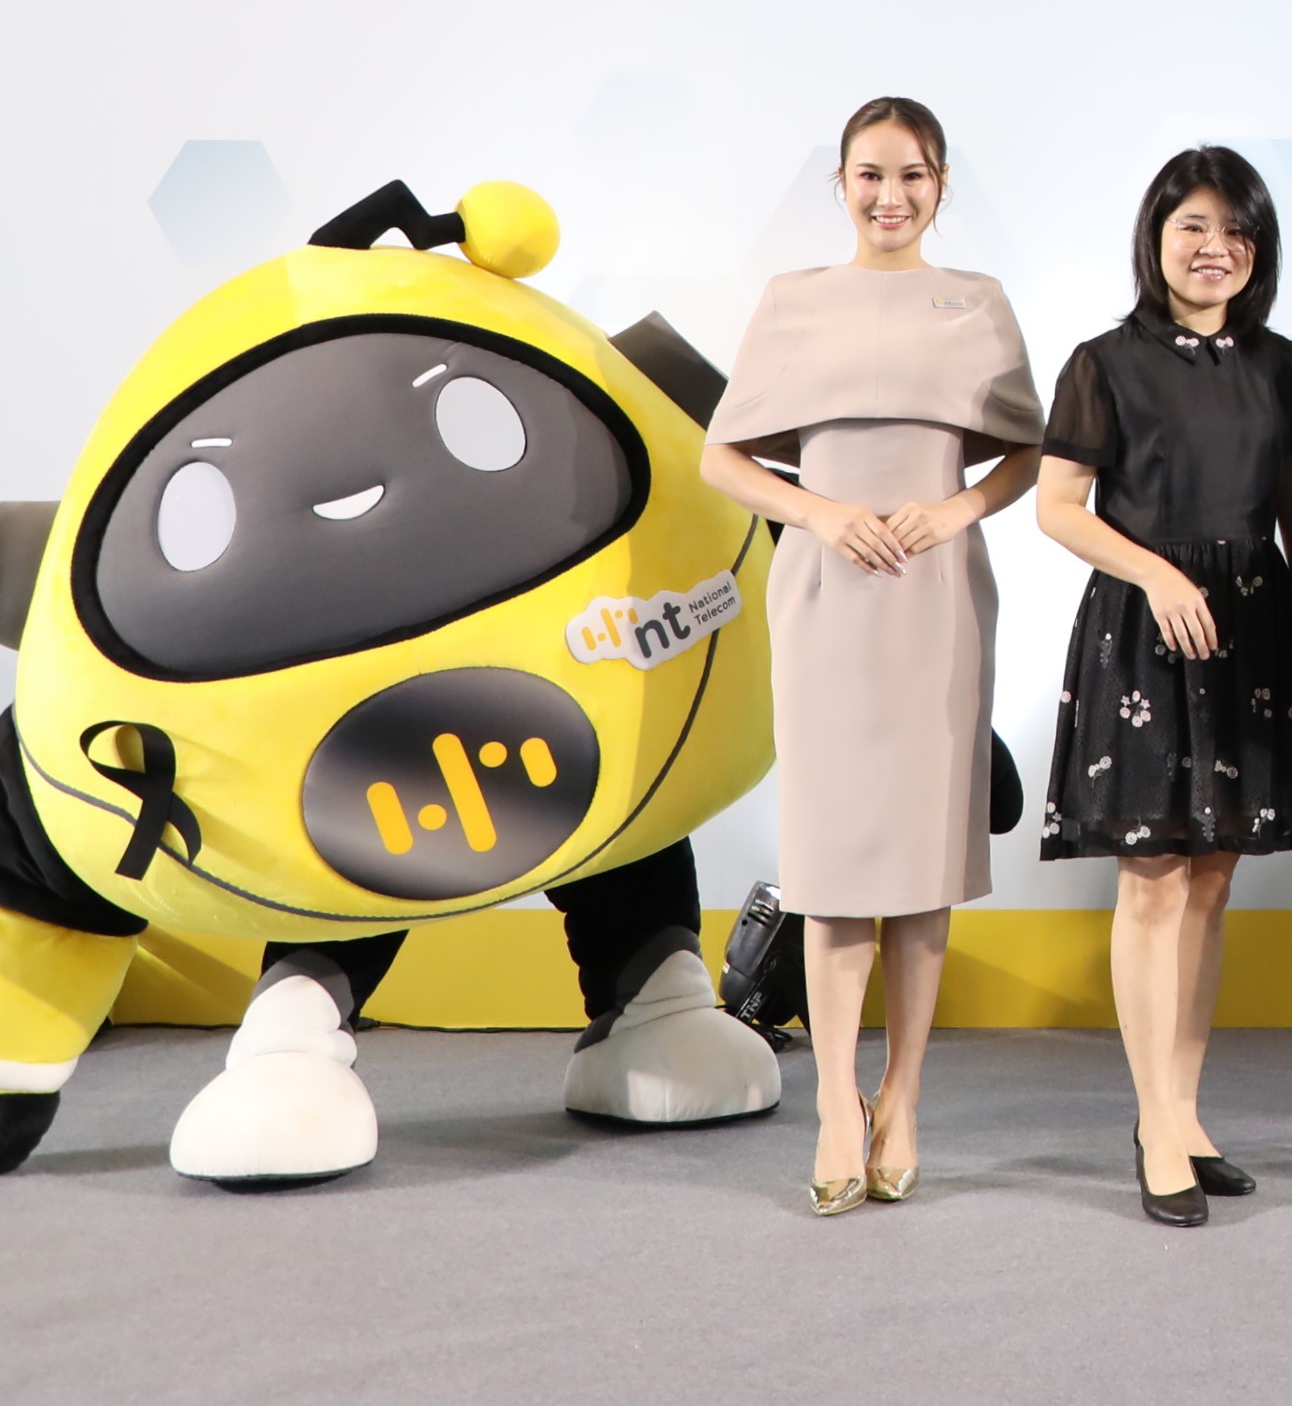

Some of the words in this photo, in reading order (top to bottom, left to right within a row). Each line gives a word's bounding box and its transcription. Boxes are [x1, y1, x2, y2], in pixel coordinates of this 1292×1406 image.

[688, 581, 733, 614] National
[694, 596, 736, 626] Telecom
[634, 602, 692, 659] nt
